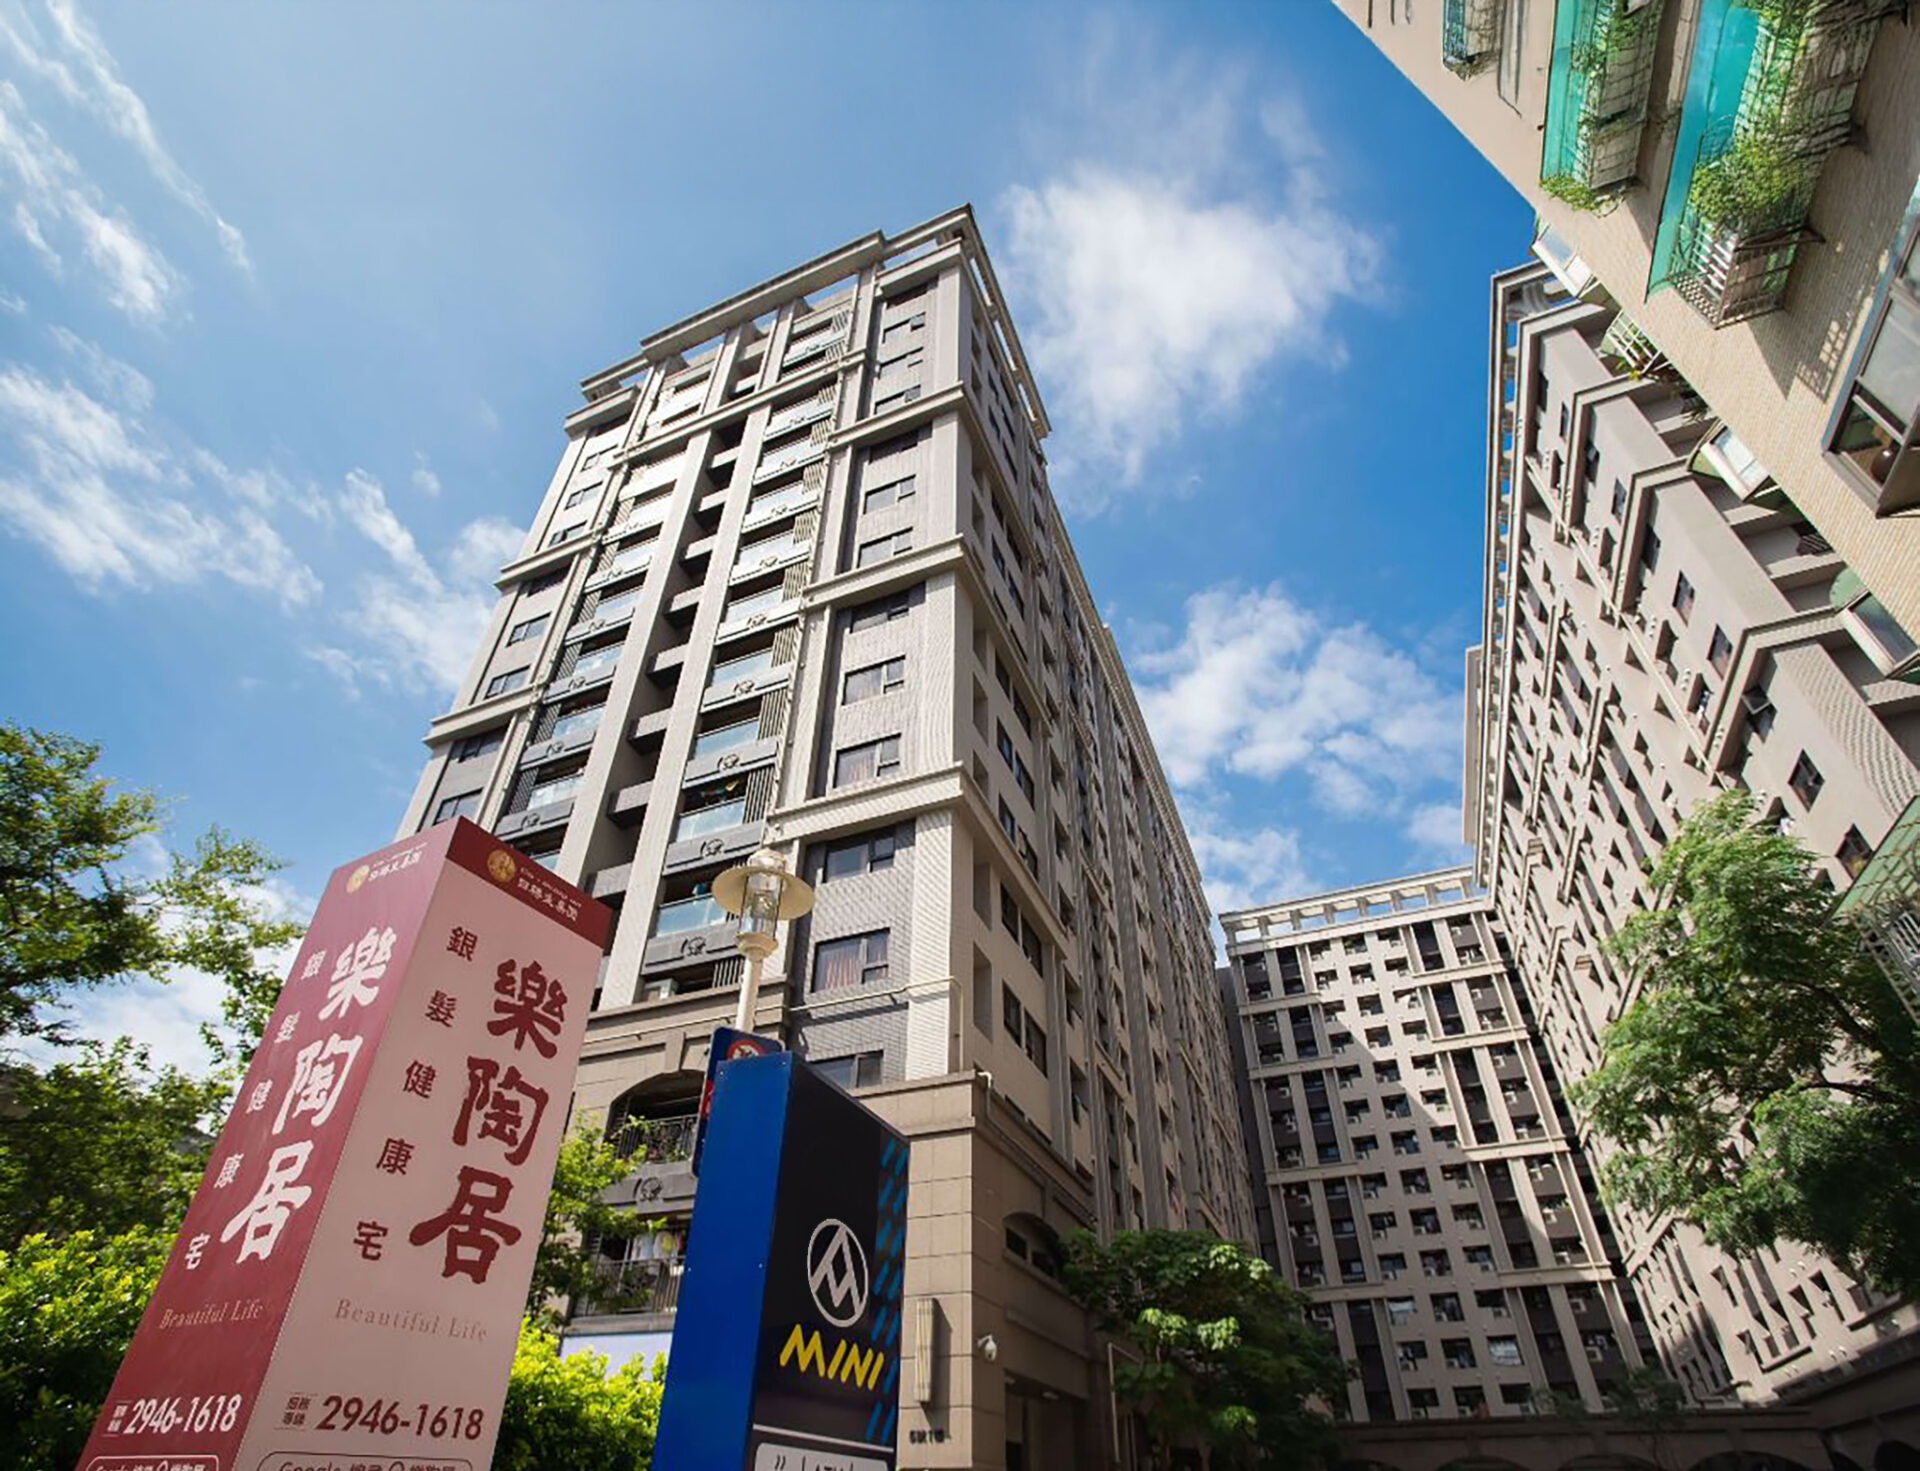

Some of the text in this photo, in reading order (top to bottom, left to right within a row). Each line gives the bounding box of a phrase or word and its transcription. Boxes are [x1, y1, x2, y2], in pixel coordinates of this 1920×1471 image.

[220, 927, 397, 1264] 樂陶居
[353, 926, 478, 1261] 銀髮健康宅
[408, 958, 568, 1284] 樂陶居
[160, 1298, 263, 1330] Beautiful Life
[335, 1299, 488, 1341] Beautiful Life
[780, 1324, 884, 1390] MINI
[123, 1394, 242, 1434] 2946-1618
[315, 1395, 484, 1440] 2946-1618
